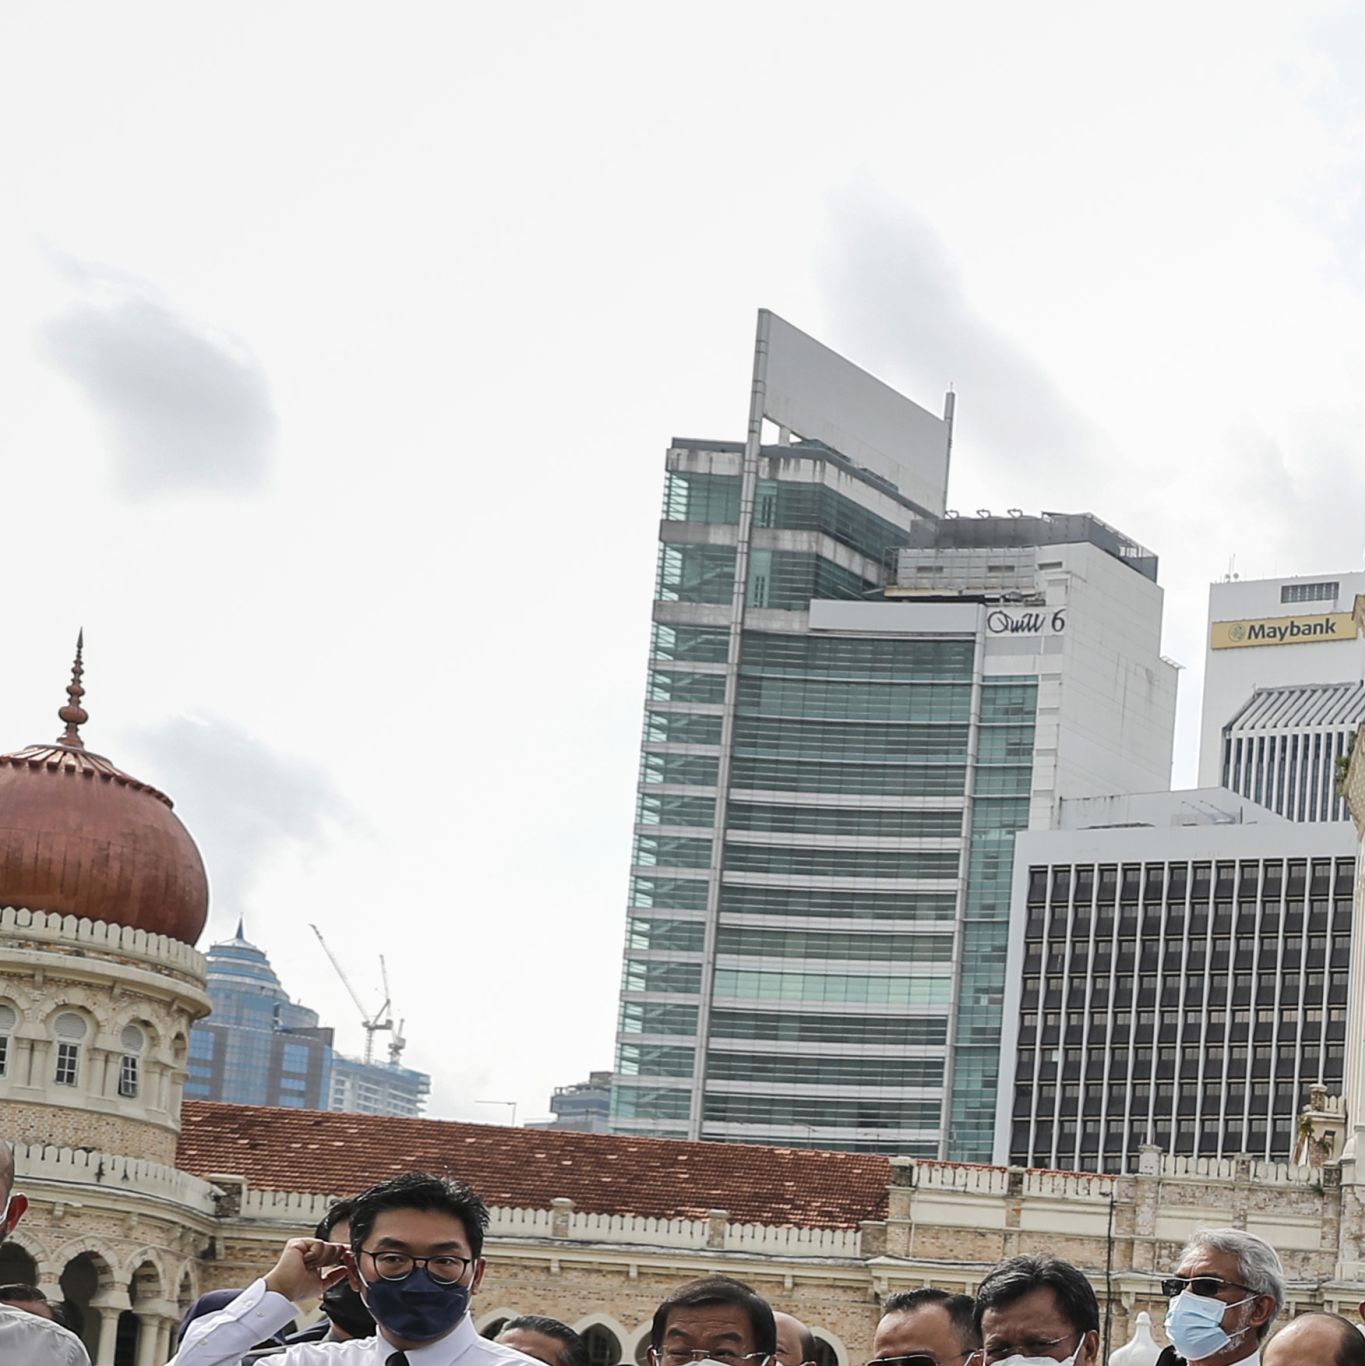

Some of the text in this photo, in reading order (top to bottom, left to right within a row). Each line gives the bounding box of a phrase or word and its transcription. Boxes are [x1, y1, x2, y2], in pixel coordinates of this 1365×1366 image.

[987, 608, 1067, 633] Quill 6
[1247, 618, 1336, 641] Maybank
